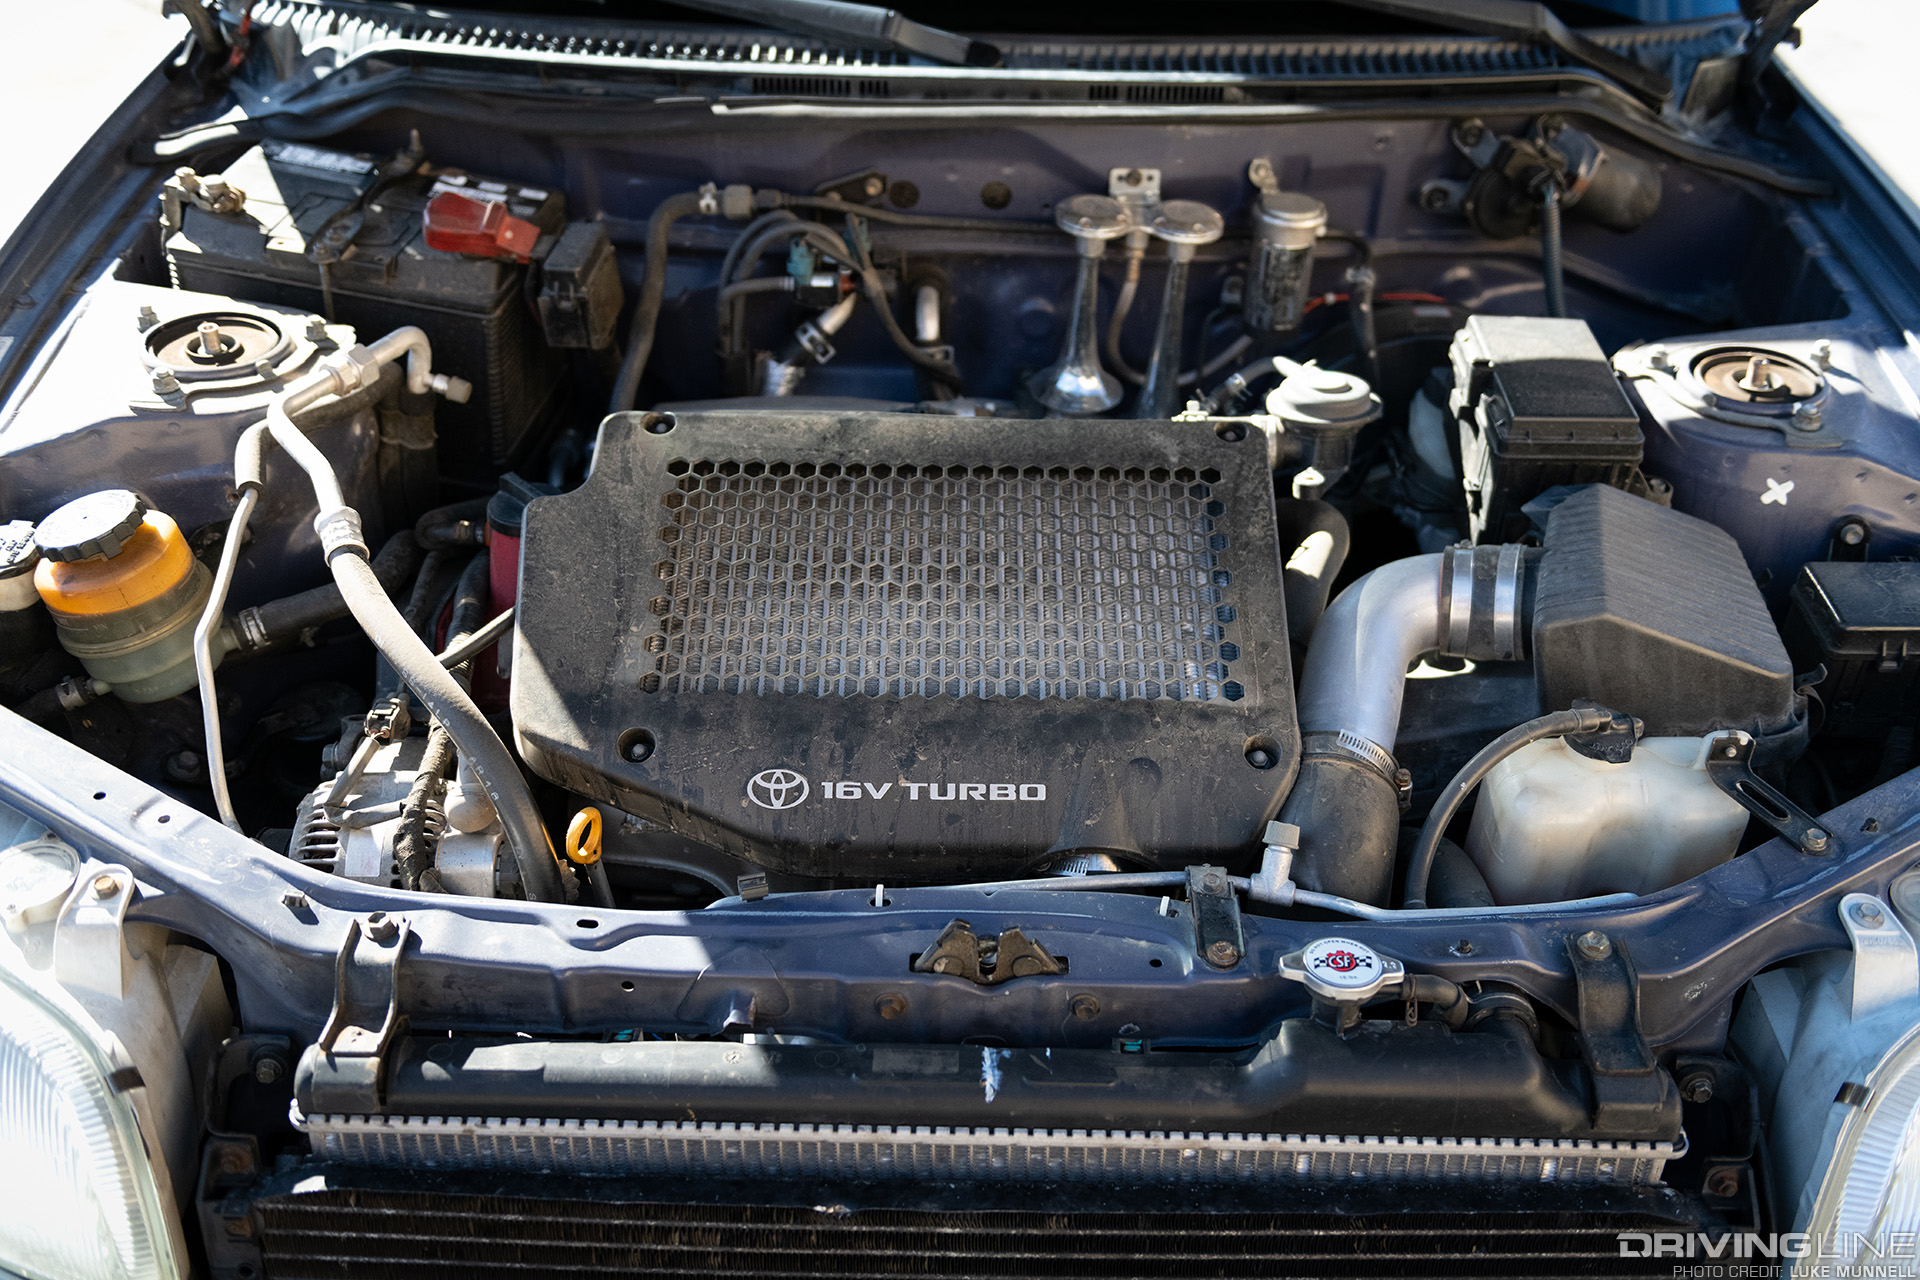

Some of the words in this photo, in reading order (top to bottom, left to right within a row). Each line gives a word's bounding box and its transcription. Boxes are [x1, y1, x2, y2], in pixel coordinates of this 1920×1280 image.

[820, 781, 893, 800] 16V
[900, 782, 1047, 801] TURBO
[1328, 955, 1352, 968] CSF
